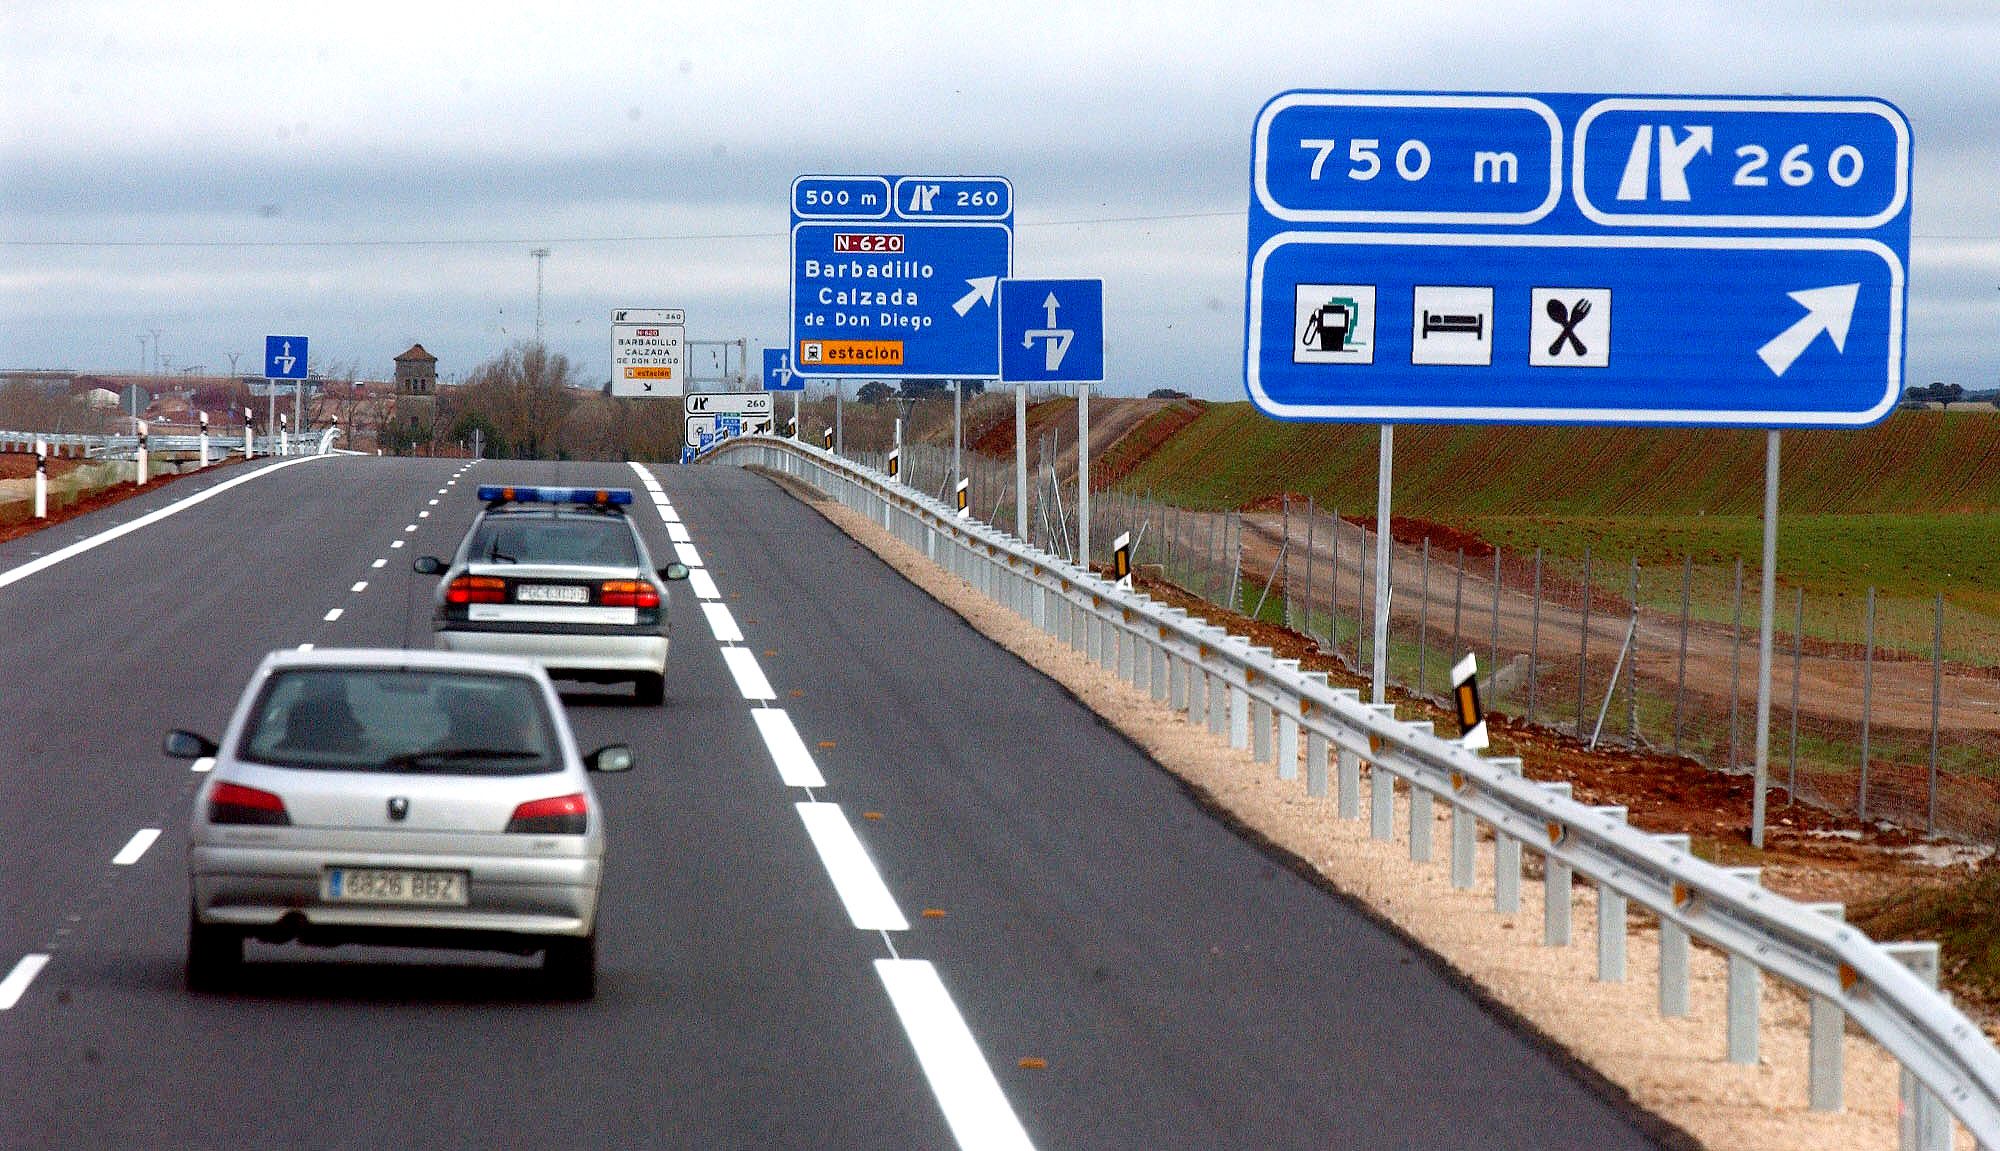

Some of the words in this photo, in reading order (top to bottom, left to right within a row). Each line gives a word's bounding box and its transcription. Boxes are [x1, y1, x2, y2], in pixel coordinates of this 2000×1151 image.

[1299, 138, 1432, 182] 750
[1473, 151, 1519, 183] m
[1733, 144, 1865, 187] 260
[805, 190, 849, 206] 500
[861, 193, 877, 206] m
[956, 191, 999, 206] 260
[836, 236, 902, 251] N-620
[805, 260, 935, 278] Barbadillo
[818, 288, 919, 306] Calzada
[804, 313, 825, 326] de
[835, 313, 870, 326] Don
[880, 313, 932, 331] Diego
[624, 348, 670, 356] CALZADA
[828, 345, 900, 360] estación
[746, 399, 766, 408] 260
